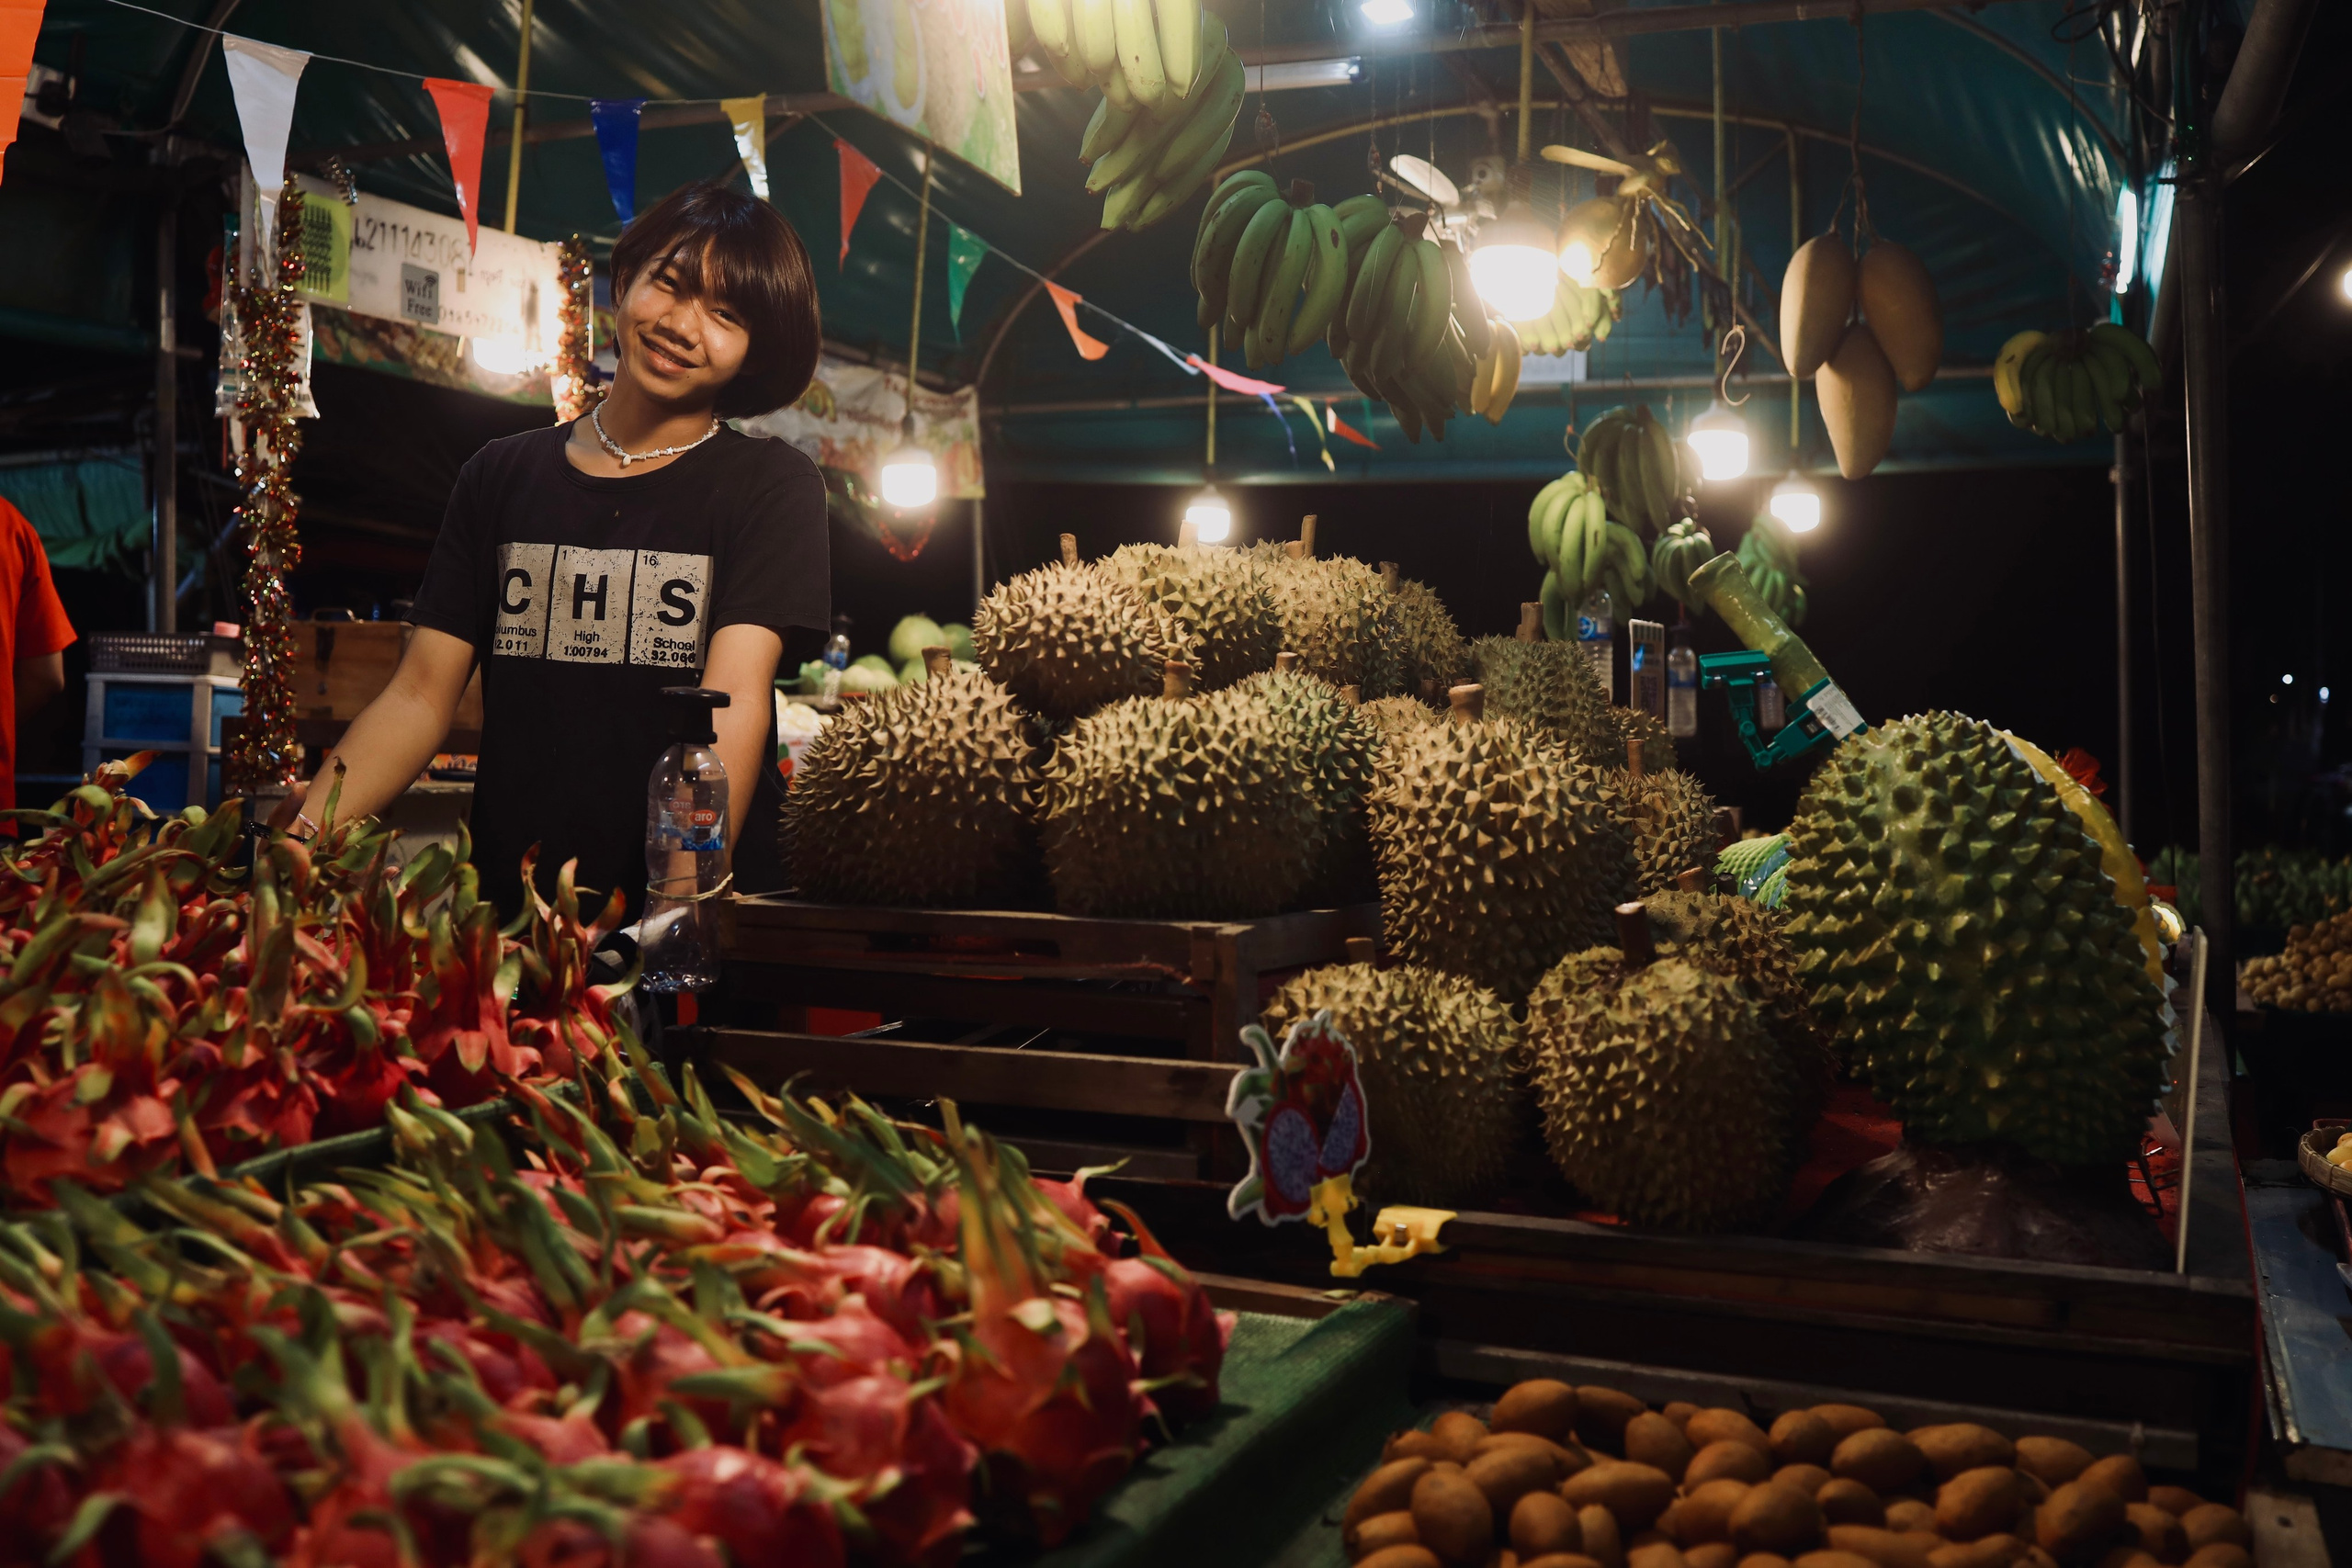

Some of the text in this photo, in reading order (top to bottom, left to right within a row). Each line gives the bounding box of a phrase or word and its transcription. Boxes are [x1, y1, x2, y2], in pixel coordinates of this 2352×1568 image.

[407, 297, 433, 317] Free
[563, 550, 568, 560] 1
[643, 555, 658, 566] 16
[500, 569, 695, 626] C H S
[496, 624, 695, 651] olumbus High School
[564, 645, 607, 658] 1.00794
[651, 650, 696, 663] 32.066
[695, 813, 713, 821] aro
